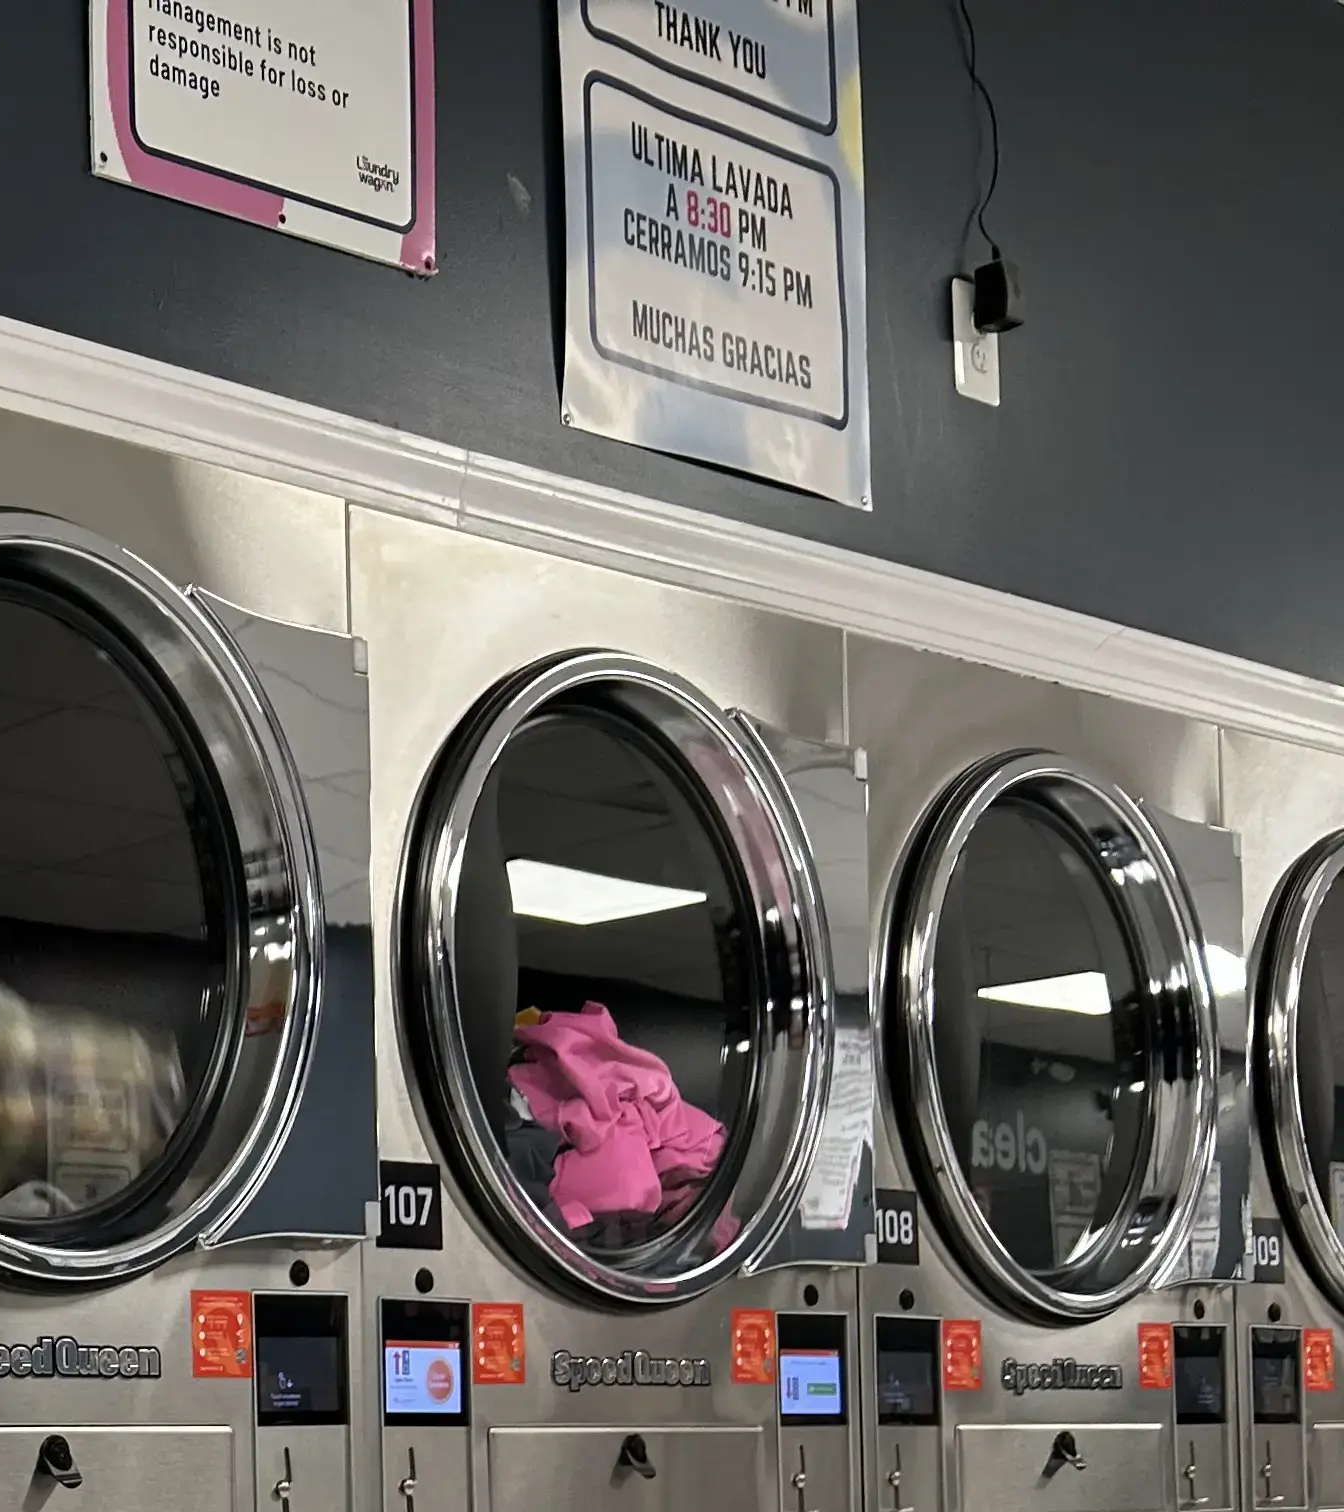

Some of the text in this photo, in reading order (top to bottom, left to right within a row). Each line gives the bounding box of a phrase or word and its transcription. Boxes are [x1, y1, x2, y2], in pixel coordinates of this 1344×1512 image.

[149, 24, 349, 108] responsible for loss or
[268, 29, 282, 55] is
[288, 41, 316, 66] not
[655, 1, 766, 79] THANK YOU
[150, 54, 220, 99] damage
[631, 121, 793, 220] ULTIMA LAVADA
[666, 183, 767, 252] A 8:30 PM
[623, 207, 813, 310] CERRAMOS 9:15 PM
[632, 300, 812, 390] MUCHAS GRACIAS
[383, 1184, 433, 1227] 107
[876, 1209, 914, 1245] 108
[54, 1337, 162, 1380] Queen
[551, 1350, 711, 1392] Speed Queen
